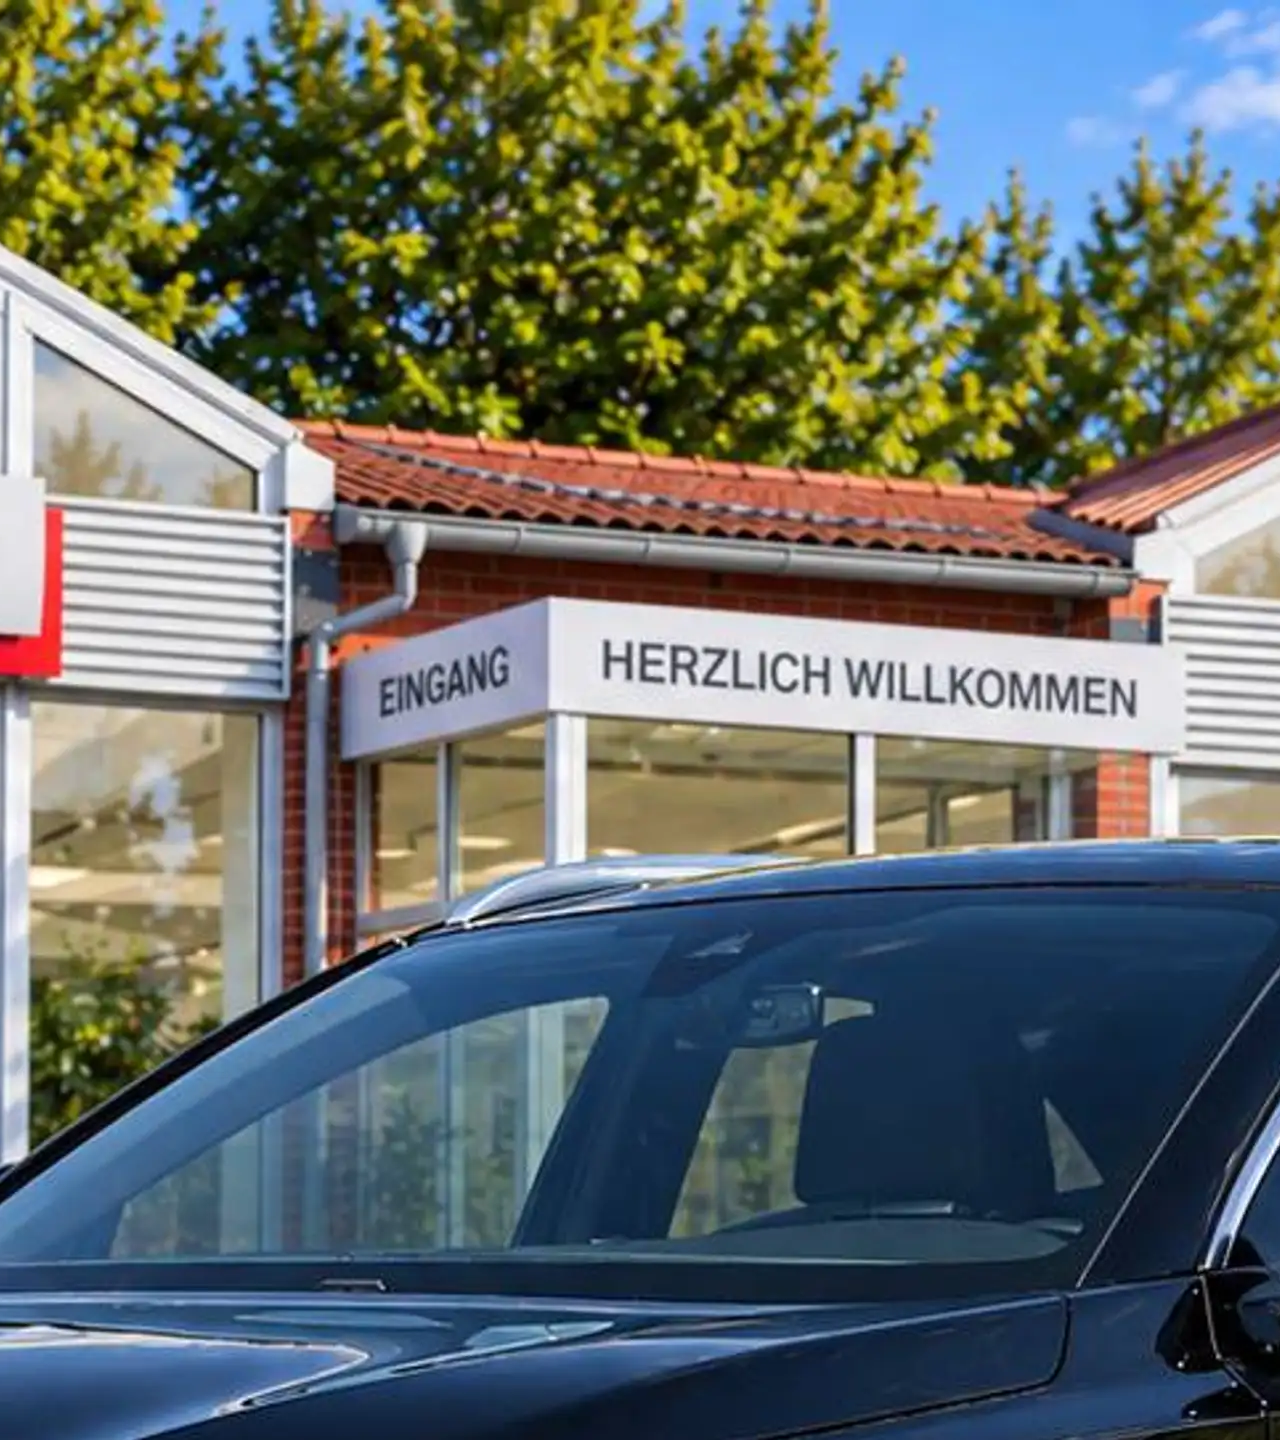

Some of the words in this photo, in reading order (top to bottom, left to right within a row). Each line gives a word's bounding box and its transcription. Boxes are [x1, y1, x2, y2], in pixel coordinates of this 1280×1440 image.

[378, 645, 510, 718] EINGANG
[602, 639, 832, 697] HERZLICH
[843, 657, 1138, 718] WILLKOMMEN
